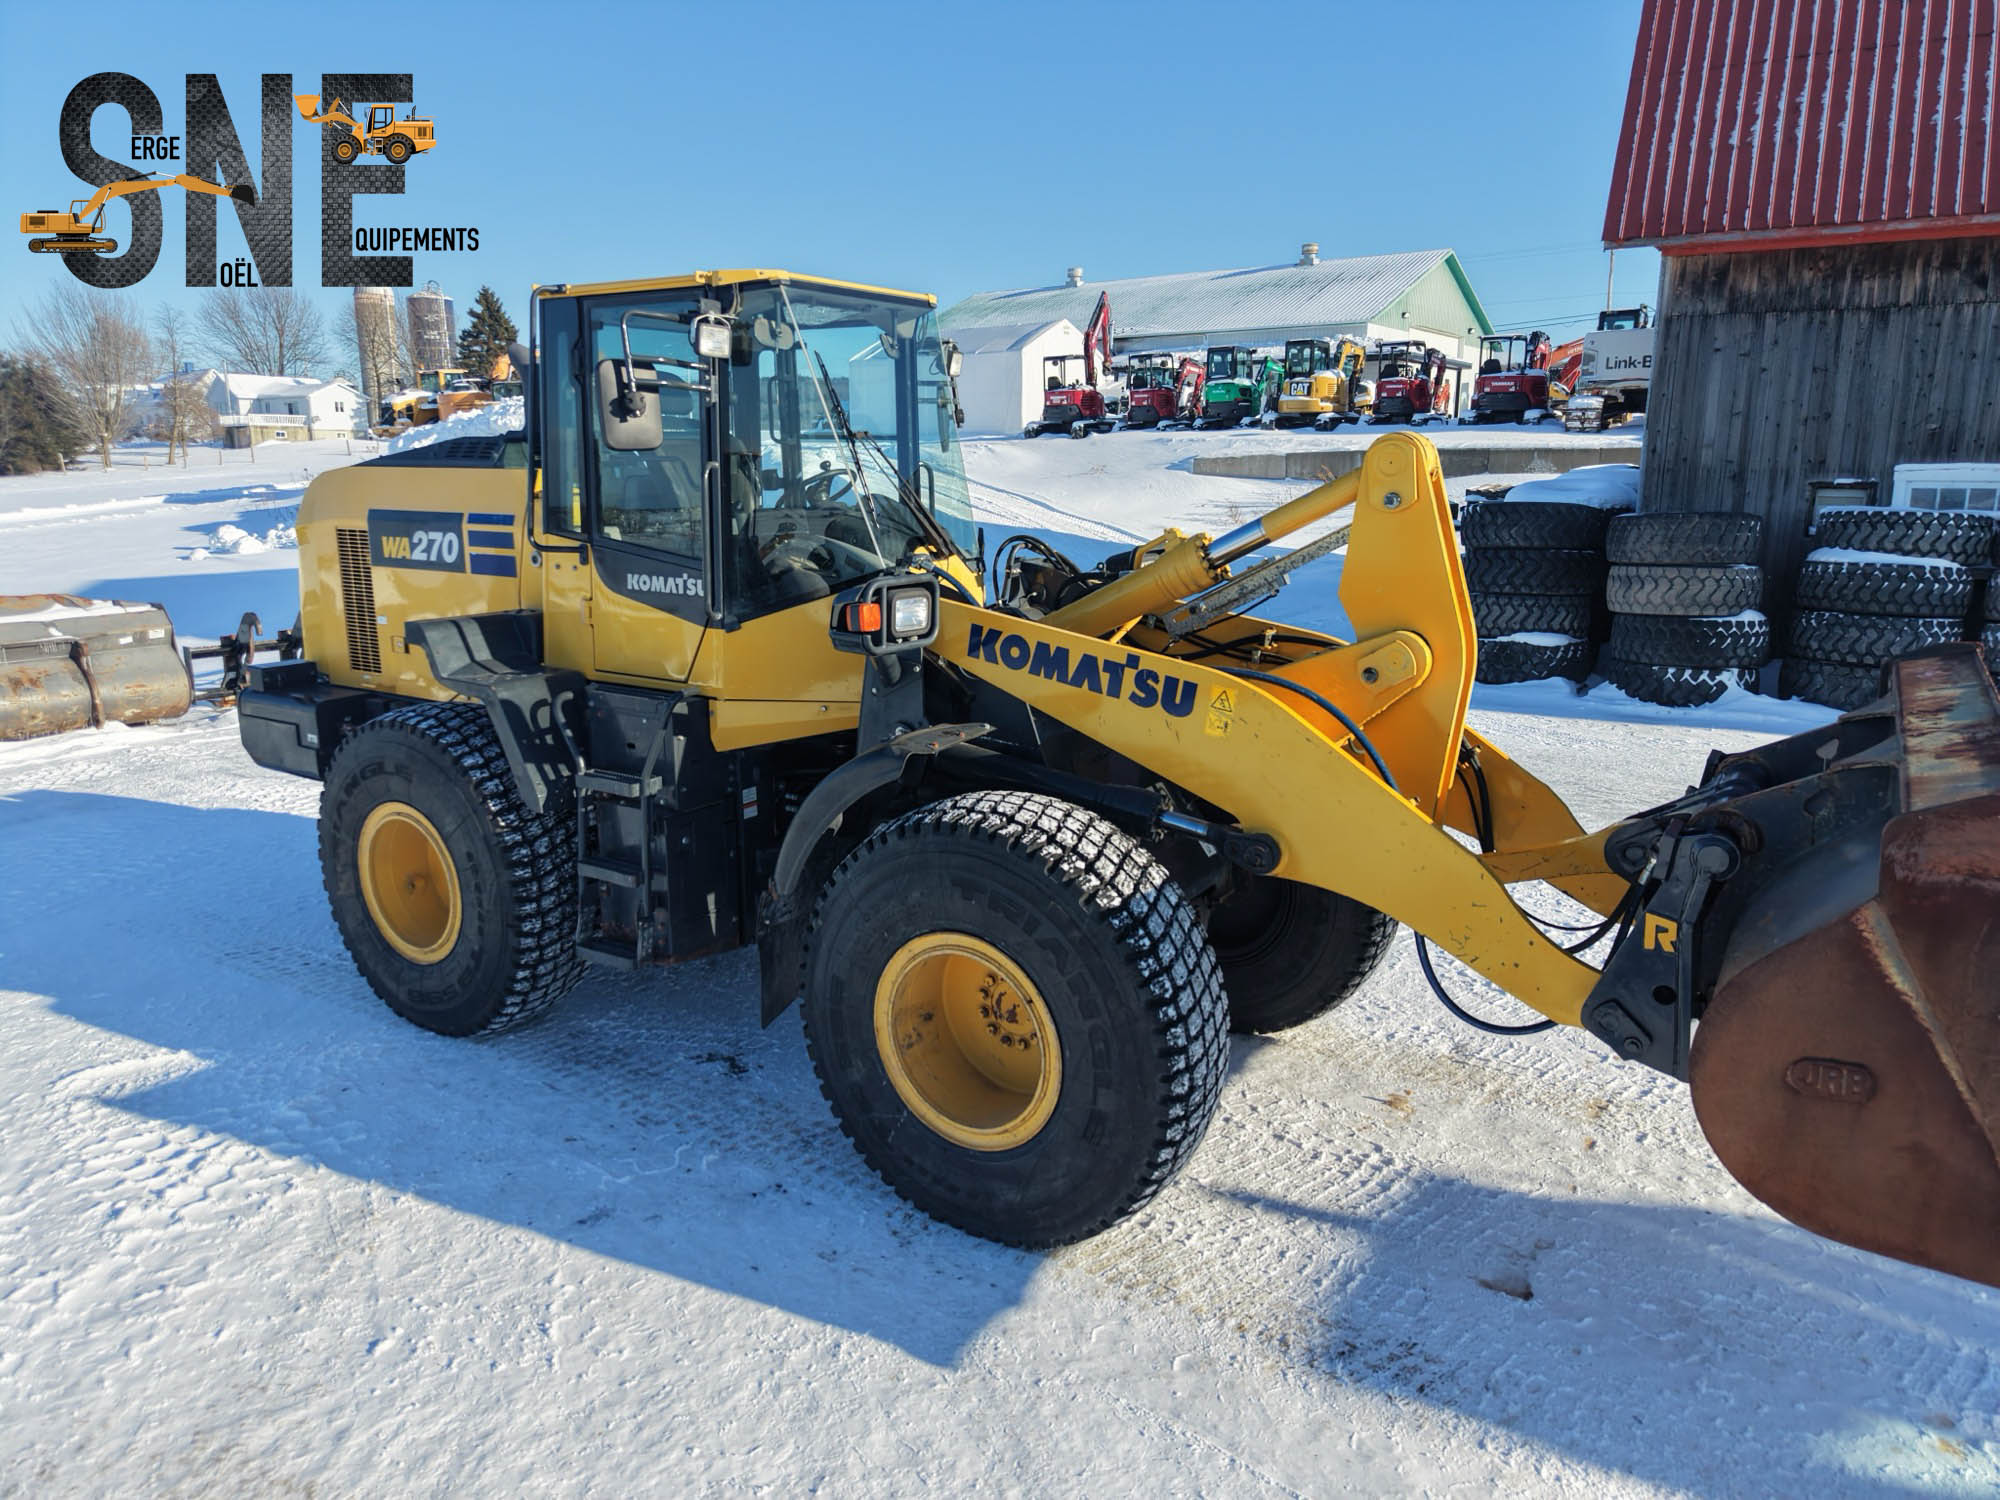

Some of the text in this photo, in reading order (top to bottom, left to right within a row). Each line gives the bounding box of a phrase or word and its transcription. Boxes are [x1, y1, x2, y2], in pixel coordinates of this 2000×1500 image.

[1291, 382, 1310, 396] CAT
[381, 530, 459, 564] WA270
[967, 623, 1199, 718] KOMATSU
[1643, 912, 1678, 953] R
